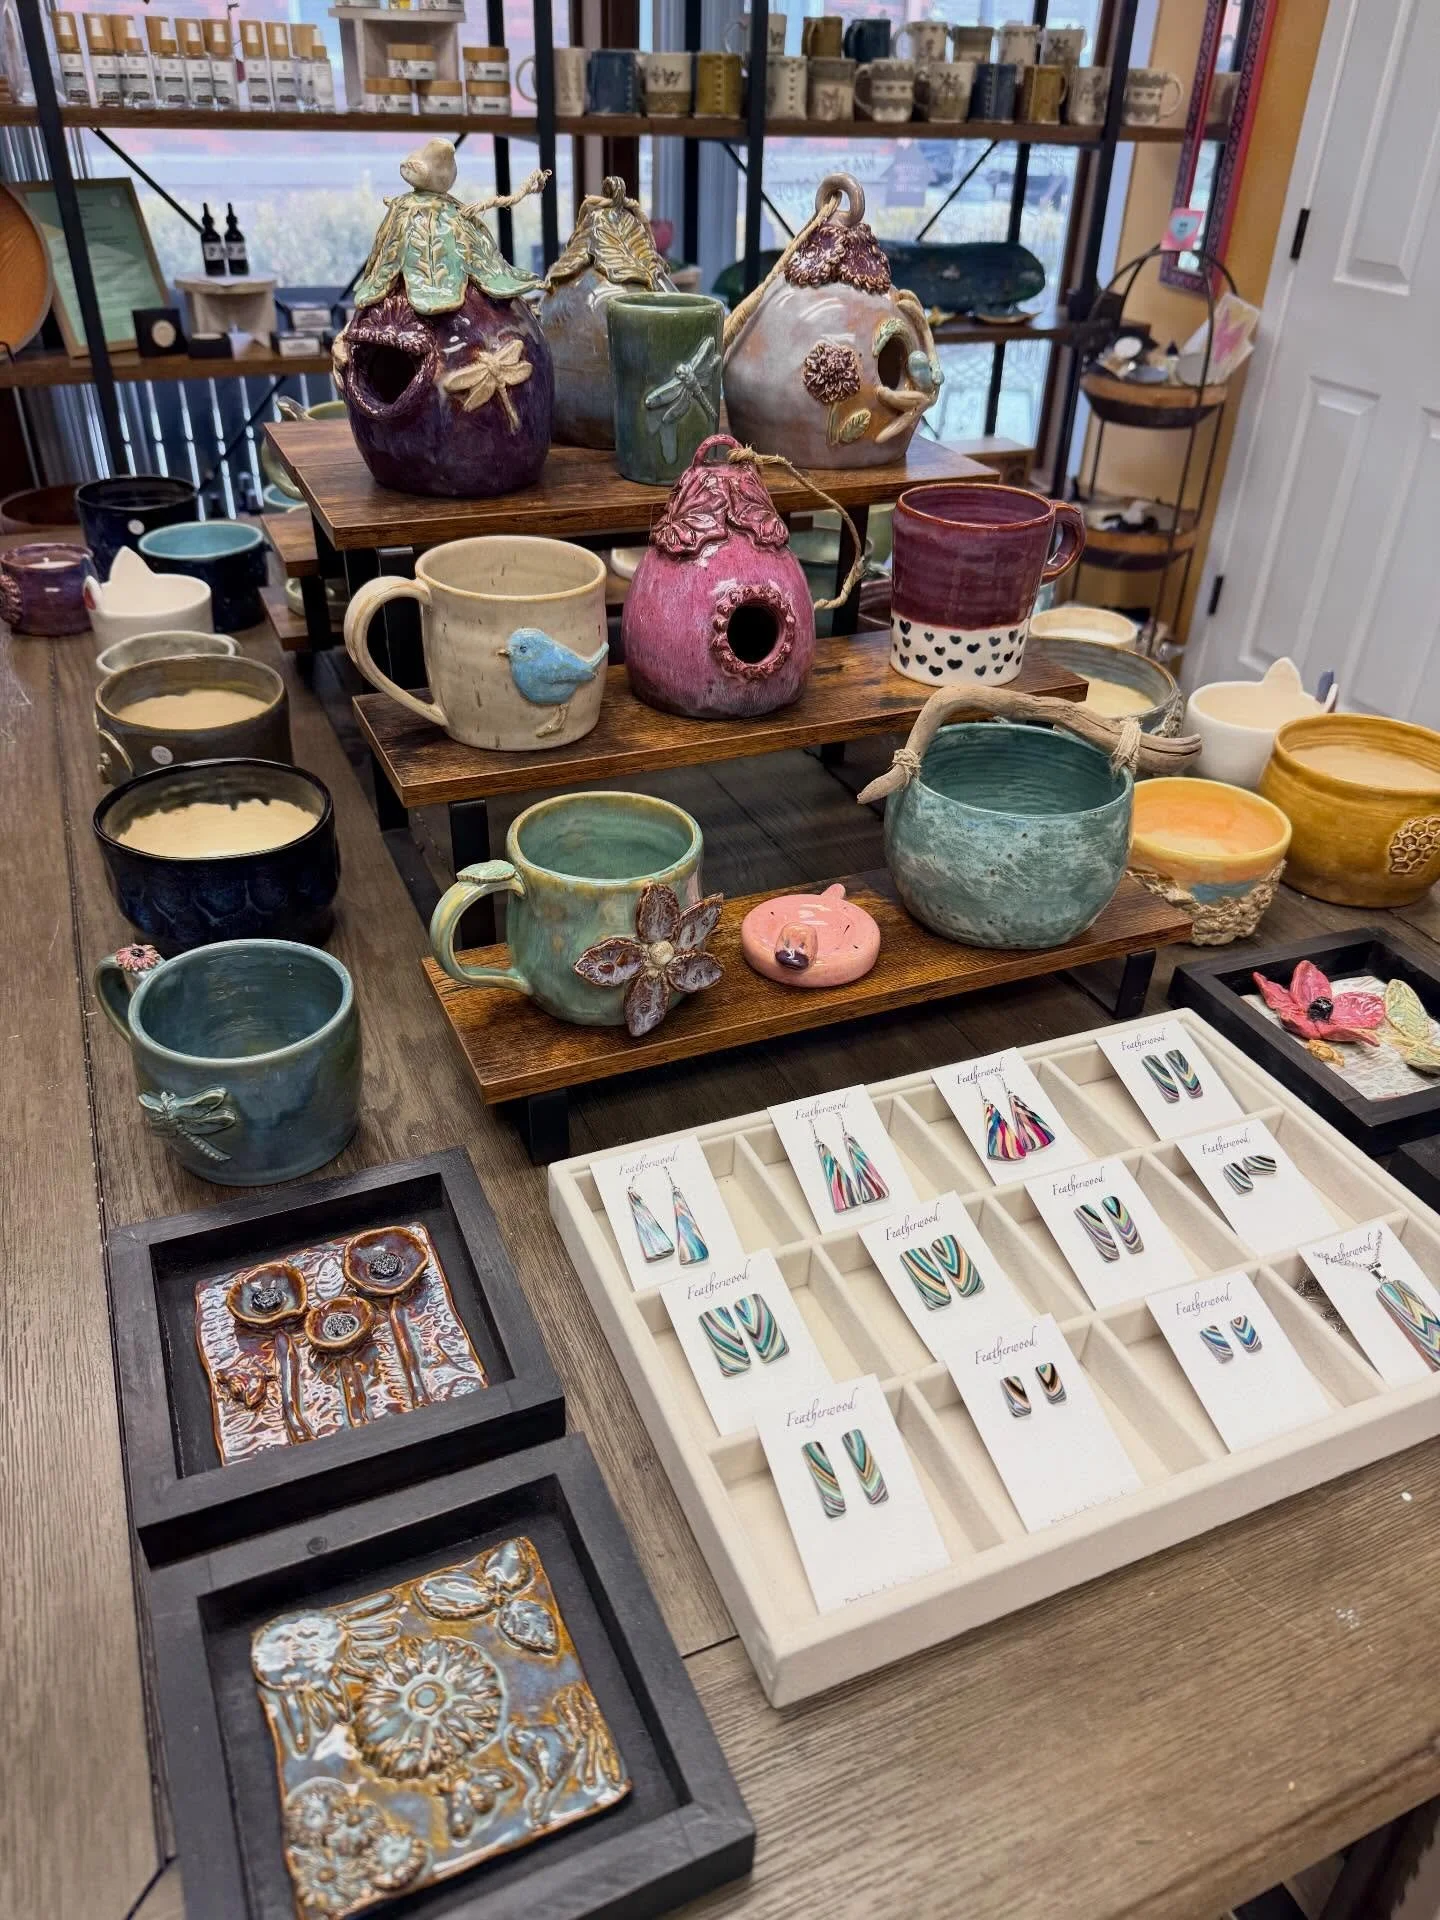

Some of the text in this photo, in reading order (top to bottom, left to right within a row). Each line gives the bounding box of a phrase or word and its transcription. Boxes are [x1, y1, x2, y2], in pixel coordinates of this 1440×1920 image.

[1052, 1166, 1105, 1196] Featherwood
[886, 1202, 941, 1240] Featherwood
[687, 1259, 751, 1300] Featherwood
[1176, 1282, 1232, 1316] Featherwood
[975, 1325, 1038, 1365] Featherwood
[787, 1387, 859, 1428] Featherwood
